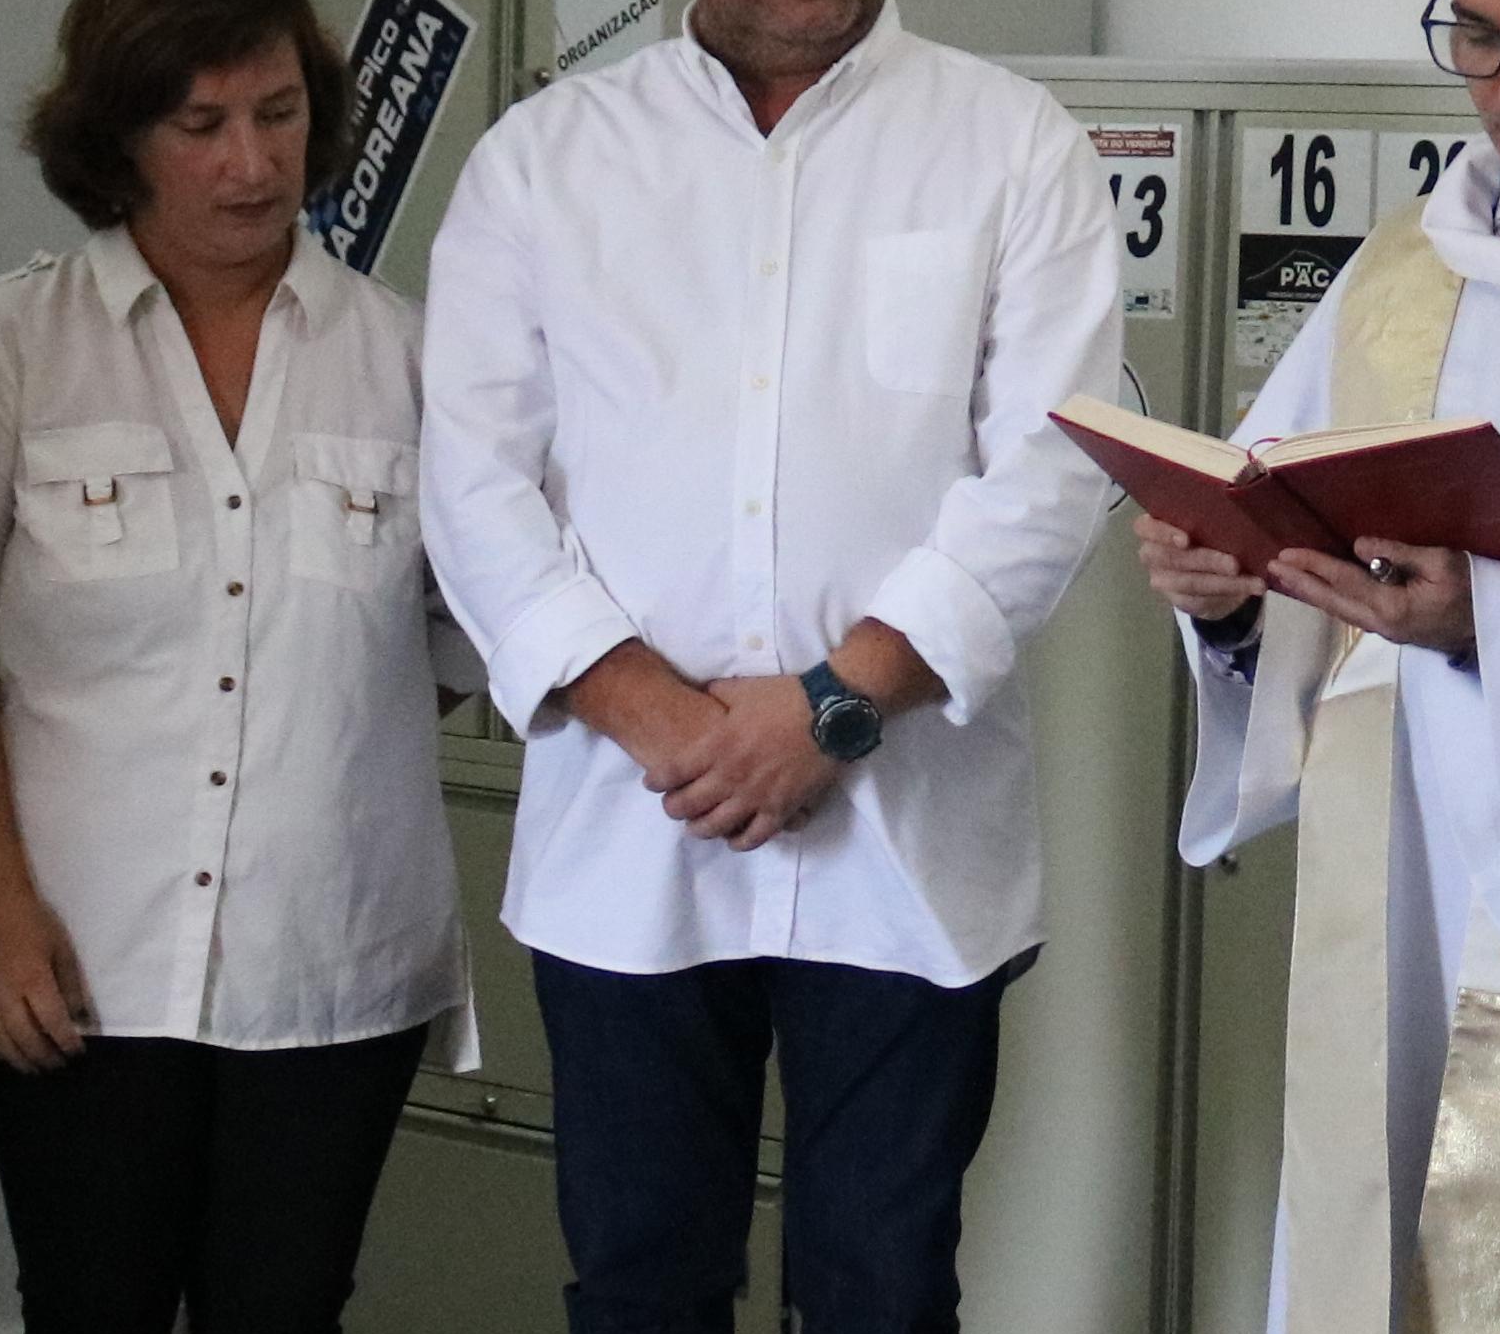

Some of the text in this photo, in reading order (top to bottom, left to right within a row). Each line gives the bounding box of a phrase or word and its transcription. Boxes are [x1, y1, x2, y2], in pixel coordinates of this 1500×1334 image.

[1269, 133, 1337, 228] 16
[1408, 139, 1466, 198] 2
[1280, 266, 1331, 288] PAC
